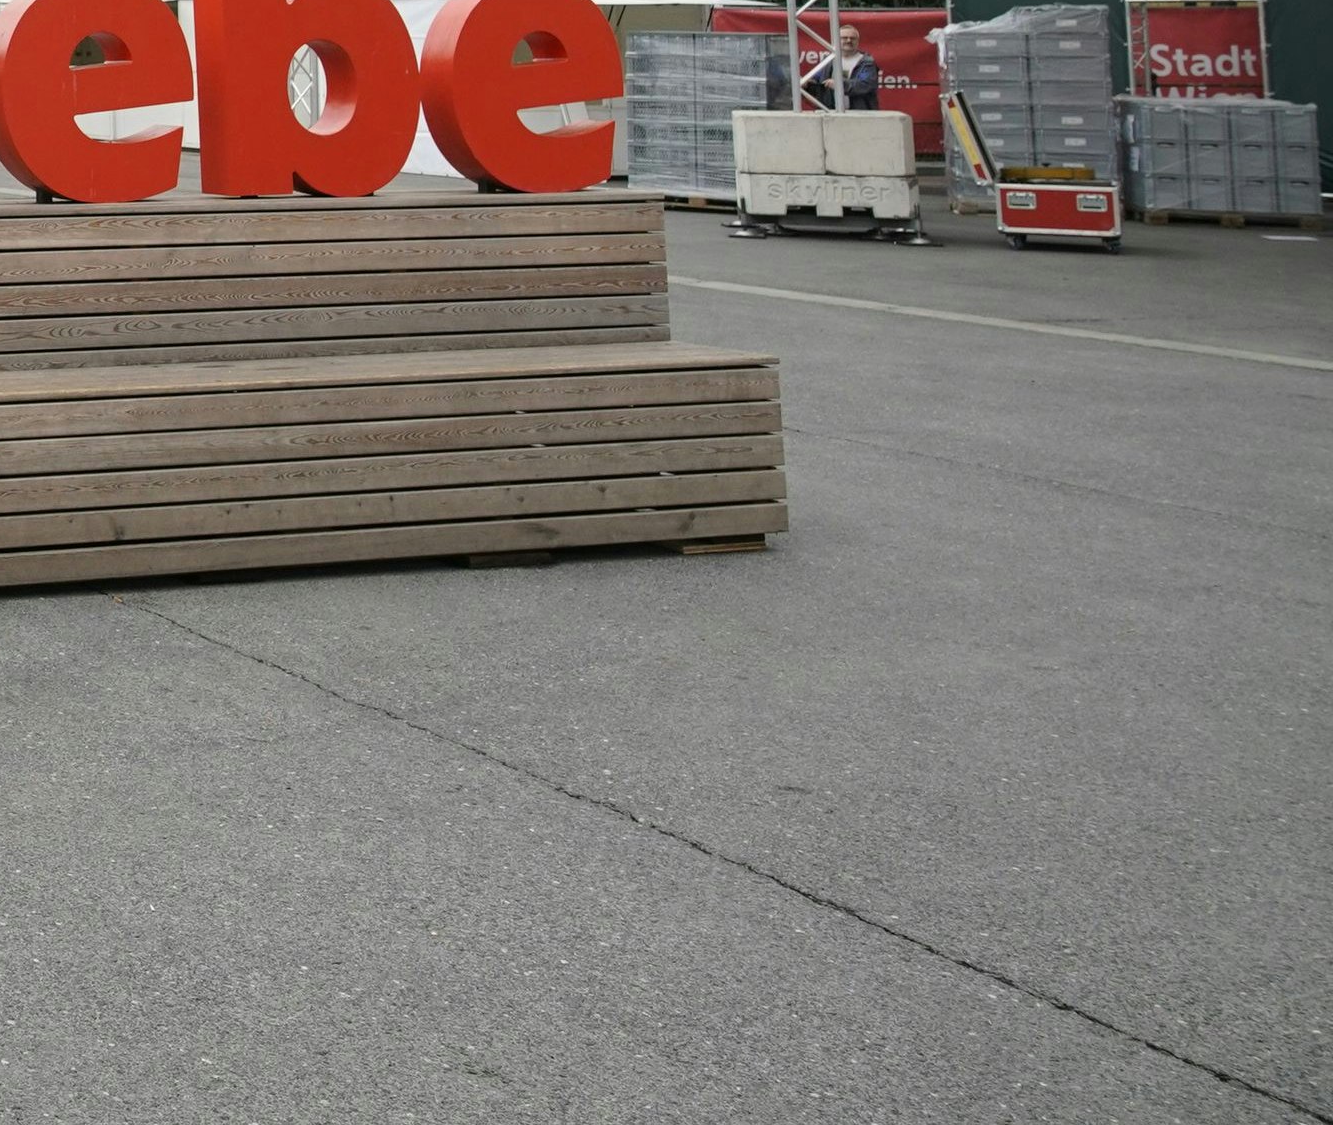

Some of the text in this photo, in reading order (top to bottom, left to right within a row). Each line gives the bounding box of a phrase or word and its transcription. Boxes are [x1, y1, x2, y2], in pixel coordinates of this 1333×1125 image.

[1149, 43, 1257, 78] Stadt
[878, 70, 918, 89] ien.
[768, 179, 891, 204] skyliner
